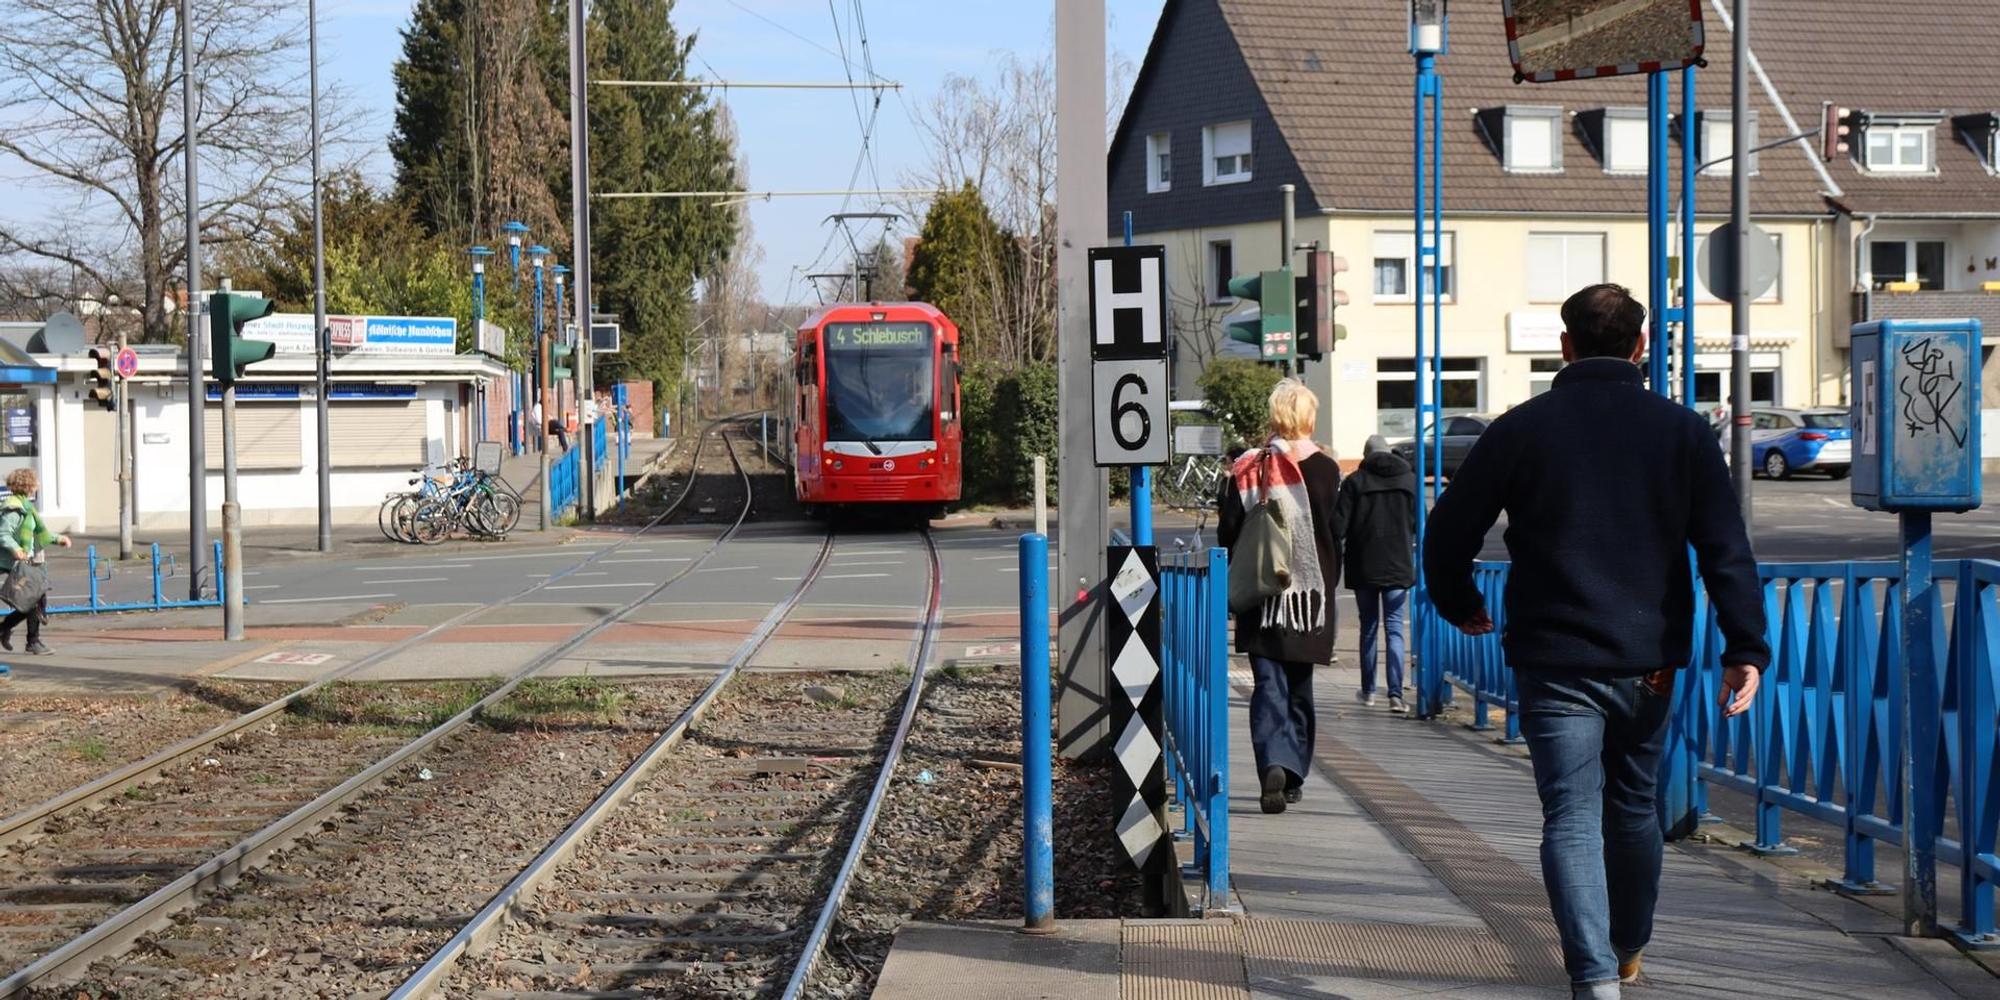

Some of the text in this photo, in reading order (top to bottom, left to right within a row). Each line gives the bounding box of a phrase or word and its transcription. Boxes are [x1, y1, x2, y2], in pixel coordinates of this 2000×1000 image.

[1094, 257, 1162, 345] H
[368, 323, 407, 337] Kölnische
[408, 324, 452, 338] Rundschau
[836, 327, 923, 345] 4 Schlebusch
[1111, 373, 1151, 451] 6
